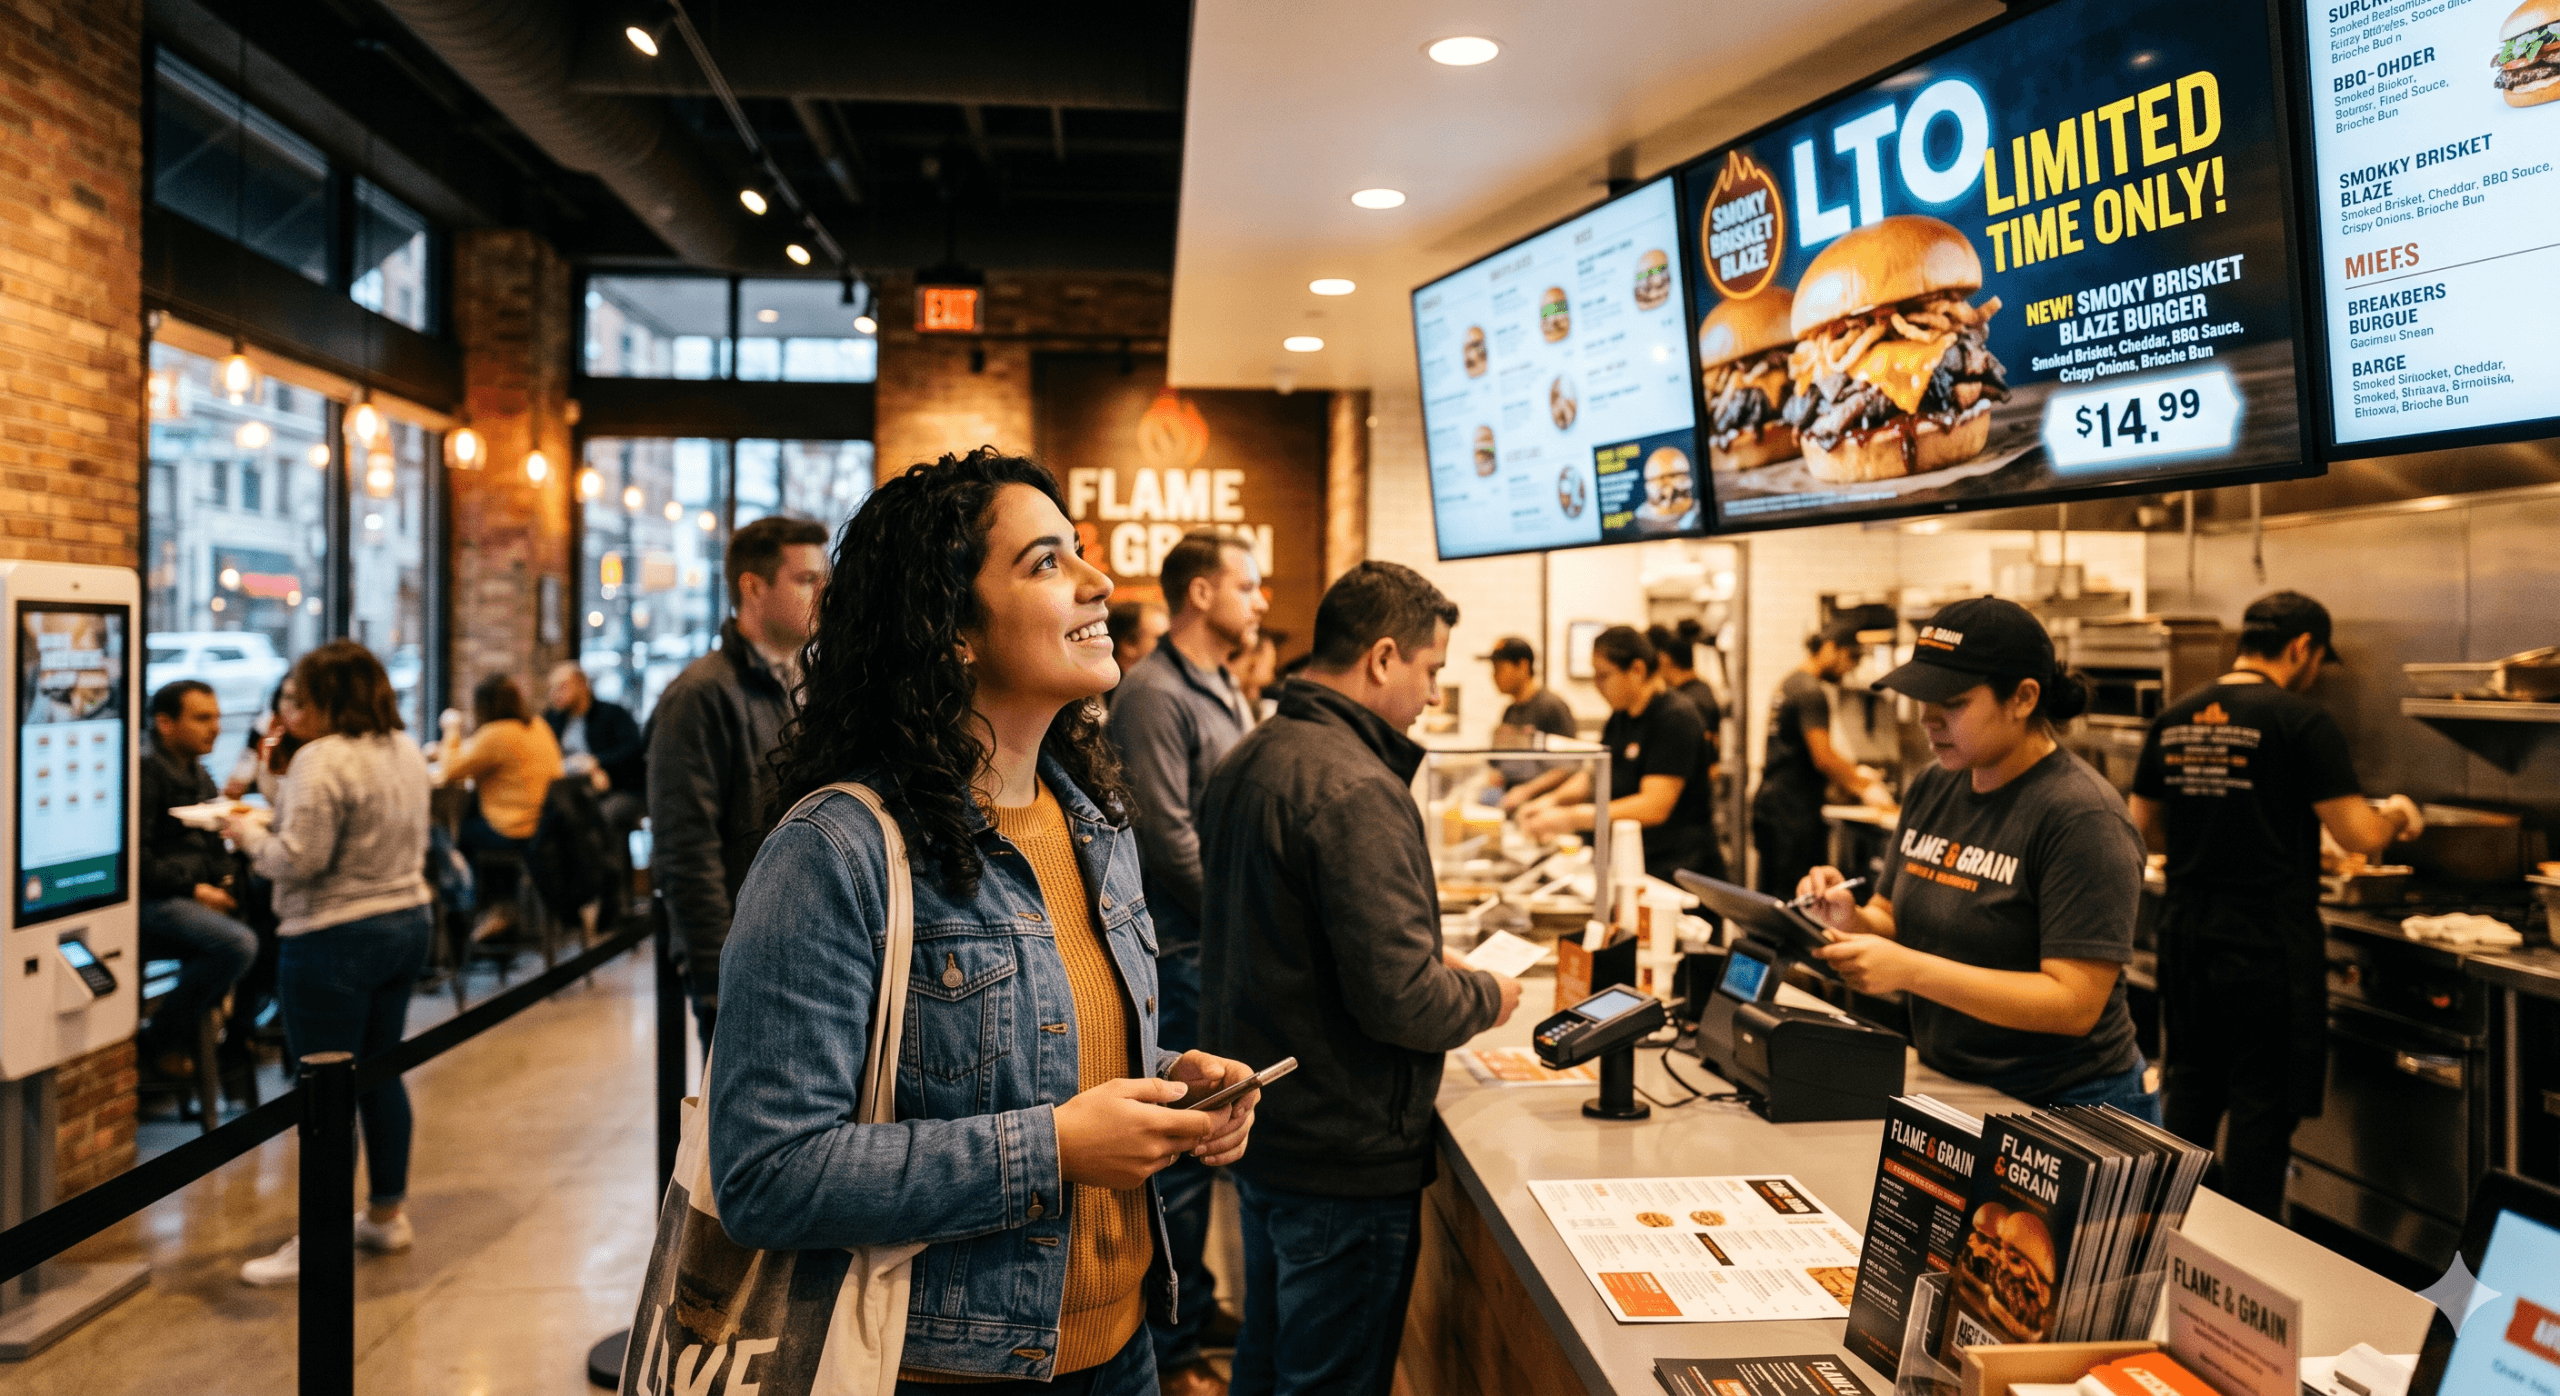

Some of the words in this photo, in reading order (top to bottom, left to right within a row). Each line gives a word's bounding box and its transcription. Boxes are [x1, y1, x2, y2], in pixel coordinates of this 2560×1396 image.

[2330, 14, 2370, 38] Smoked
[2331, 44, 2370, 63] Brioche
[2334, 85, 2375, 107] Smoked
[1984, 70, 2222, 216] LIMITED
[2336, 115, 2375, 134] Brioche
[2378, 108, 2399, 121] Bun
[1792, 78, 1990, 248] LTO
[2339, 155, 2411, 190] SMOKKY
[2415, 133, 2493, 170] BRISKET
[1711, 188, 1767, 232] SMOKY
[1985, 199, 2084, 273] TIME
[2093, 155, 2227, 245] ONLY!
[2340, 180, 2393, 208] BLAZE
[2341, 202, 2382, 222] Smoked
[2428, 180, 2479, 201] Cheddar,
[2482, 170, 2509, 187] BBQ
[2511, 162, 2554, 180] Sauce,
[1709, 212, 1774, 259] BRISKET
[2342, 221, 2374, 236] Crispy
[2417, 199, 2459, 218] Brioche
[2462, 193, 2485, 207] Bun
[1720, 241, 1769, 282] BLAZE
[2025, 294, 2074, 326] NEW!
[2077, 276, 2148, 315] SMOKY
[2153, 253, 2244, 298] BRISKET
[2348, 283, 2446, 316] BREAKBERS
[2059, 311, 2120, 346] BLAZE
[2123, 293, 2208, 333] BURGER
[2075, 343, 2117, 363] Brisket,
[2118, 334, 2170, 354] Cheddar,
[2172, 326, 2199, 344] BBQ
[2201, 320, 2244, 339] Sauce,
[2349, 308, 2418, 335] BURGUE
[2060, 365, 2095, 383] Crispy
[2096, 358, 2139, 376] Onions,
[2141, 348, 2186, 368] Brioche
[2188, 345, 2214, 360] Bun
[2352, 354, 2406, 377] BARGE
[2352, 375, 2395, 391] Smoked
[2454, 360, 2506, 376] Cheddar,
[2075, 388, 2200, 448] $14.99
[2353, 389, 2399, 405] Smoked,
[2402, 397, 2443, 412] Brioche
[2446, 394, 2469, 406] Bun
[1068, 467, 1246, 522] FLAME
[1900, 828, 1949, 865] FLAME
[1943, 842, 1961, 868] &
[1956, 845, 2018, 885] GRAIN
[1890, 1118, 1928, 1154] FLAME
[1926, 1136, 1937, 1159] &
[1937, 1140, 1975, 1178] GRAIN
[2001, 1133, 2062, 1180] FLAME
[1994, 1156, 2006, 1177] &
[2008, 1162, 2059, 1205] GRAIN
[2174, 1256, 2220, 1309] FLAME
[2223, 1286, 2235, 1315] &
[2238, 1293, 2287, 1348] GRAIN
